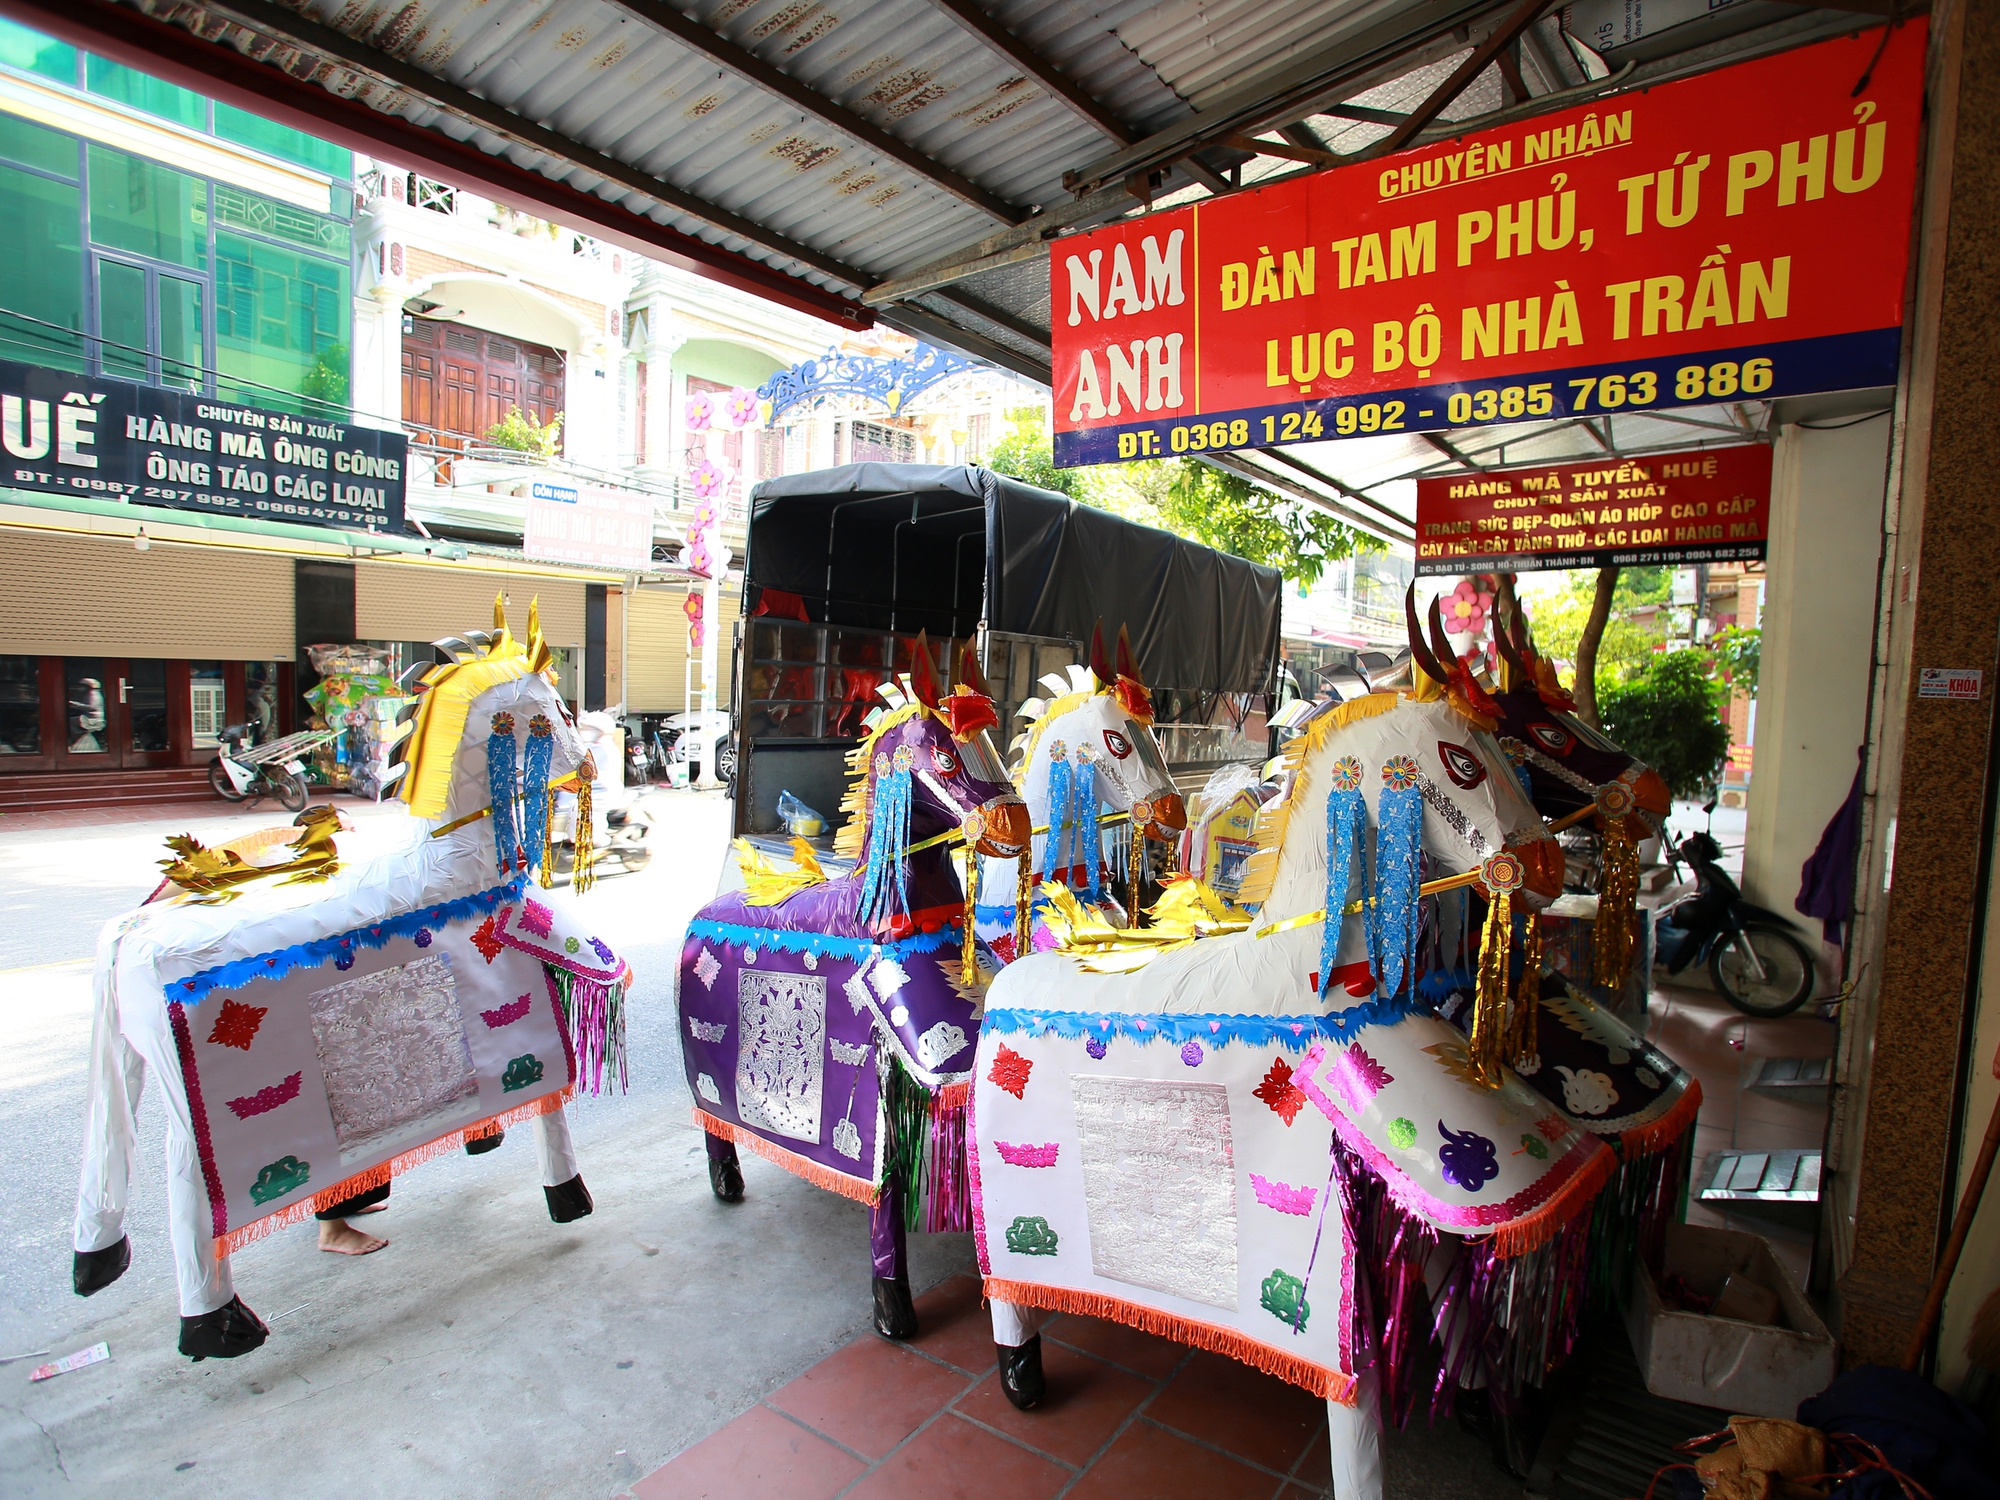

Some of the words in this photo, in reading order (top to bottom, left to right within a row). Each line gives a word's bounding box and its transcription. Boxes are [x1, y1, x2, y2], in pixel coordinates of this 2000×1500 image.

[1379, 142, 1512, 198] CHUYÊN
[1524, 109, 1633, 166] NHẬN
[1220, 245, 1316, 312] ĐÀN
[1331, 219, 1437, 290] TAM
[1456, 172, 1595, 268] PHỦ,
[1618, 150, 1711, 236] TỨ
[1725, 100, 1887, 218] PHỦ
[1065, 229, 1186, 327] NAM
[1266, 328, 1355, 394] LỤC
[1373, 302, 1442, 379] BỘ
[1461, 279, 1584, 361] NHÀ
[1605, 243, 1792, 341] TRẦN
[1069, 332, 1184, 422] ANH
[197, 404, 265, 429] CHUYÊN
[268, 415, 303, 435] SẢN
[307, 423, 345, 442] XUẤT
[1117, 430, 1160, 459] ĐT:
[1170, 419, 1249, 453] 0368
[1261, 410, 1324, 443] 124
[1335, 400, 1406, 435] 992
[1447, 382, 1553, 424] 0385
[1568, 371, 1658, 412] 763
[1675, 357, 1774, 401] 886
[125, 414, 212, 452] HÀNG
[220, 431, 267, 461] MÃ
[273, 436, 328, 470] ÔNG
[334, 449, 400, 481] CÔNG
[71, 477, 140, 495] 0987
[144, 487, 193, 501] 297
[196, 493, 240, 508] 992
[256, 500, 310, 516] 0965
[312, 508, 350, 521] 479
[352, 512, 389, 525] 789
[146, 451, 211, 487] ÔNG
[217, 464, 269, 495] TÁO
[274, 474, 327, 502] CÁC
[332, 482, 386, 512] LOẠI
[1450, 480, 1512, 498] HÀNG
[1522, 472, 1561, 492] MÃ
[1571, 461, 1652, 487] TUYỂN
[1662, 456, 1718, 479] HUỆ
[1570, 488, 1609, 503] SẢN
[1616, 482, 1668, 500] XUẤT
[595, 513, 619, 547] CÁC
[1420, 540, 1444, 557] CÂY
[1514, 533, 1553, 552] VÀNG
[1631, 528, 1669, 545] LOẠI
[1675, 522, 1723, 541] HÀNG
[1730, 518, 1760, 538] MÃ
[1424, 520, 1471, 536] TRANG
[1477, 514, 1508, 532] SỨC
[1599, 506, 1623, 524] ÁO
[1670, 502, 1708, 519] CAO
[1716, 494, 1757, 515] CẤP
[1949, 676, 1978, 692] KHÓA
